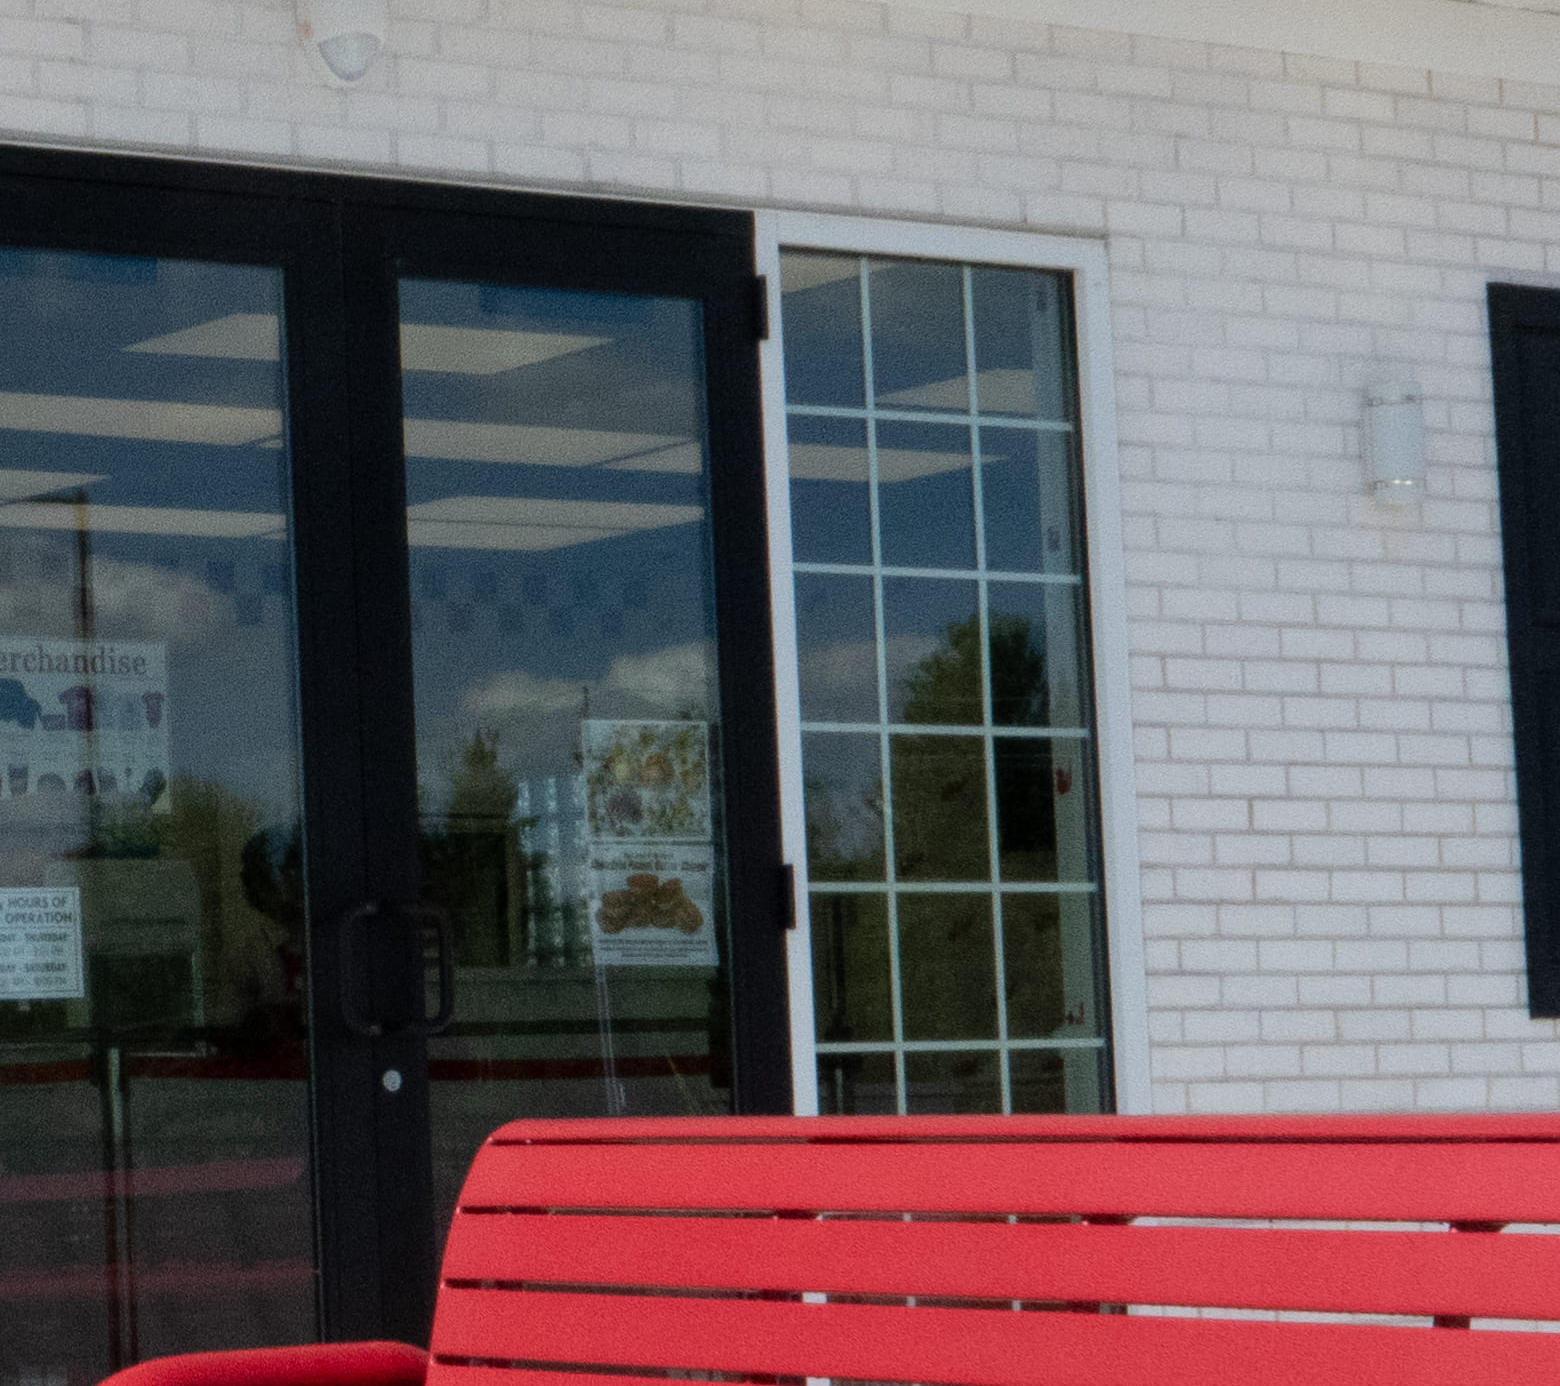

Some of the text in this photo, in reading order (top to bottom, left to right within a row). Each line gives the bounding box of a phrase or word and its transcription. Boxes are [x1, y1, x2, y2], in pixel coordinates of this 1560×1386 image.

[7, 896, 67, 909] HOURS OF
[4, 911, 73, 924] OPERATION
